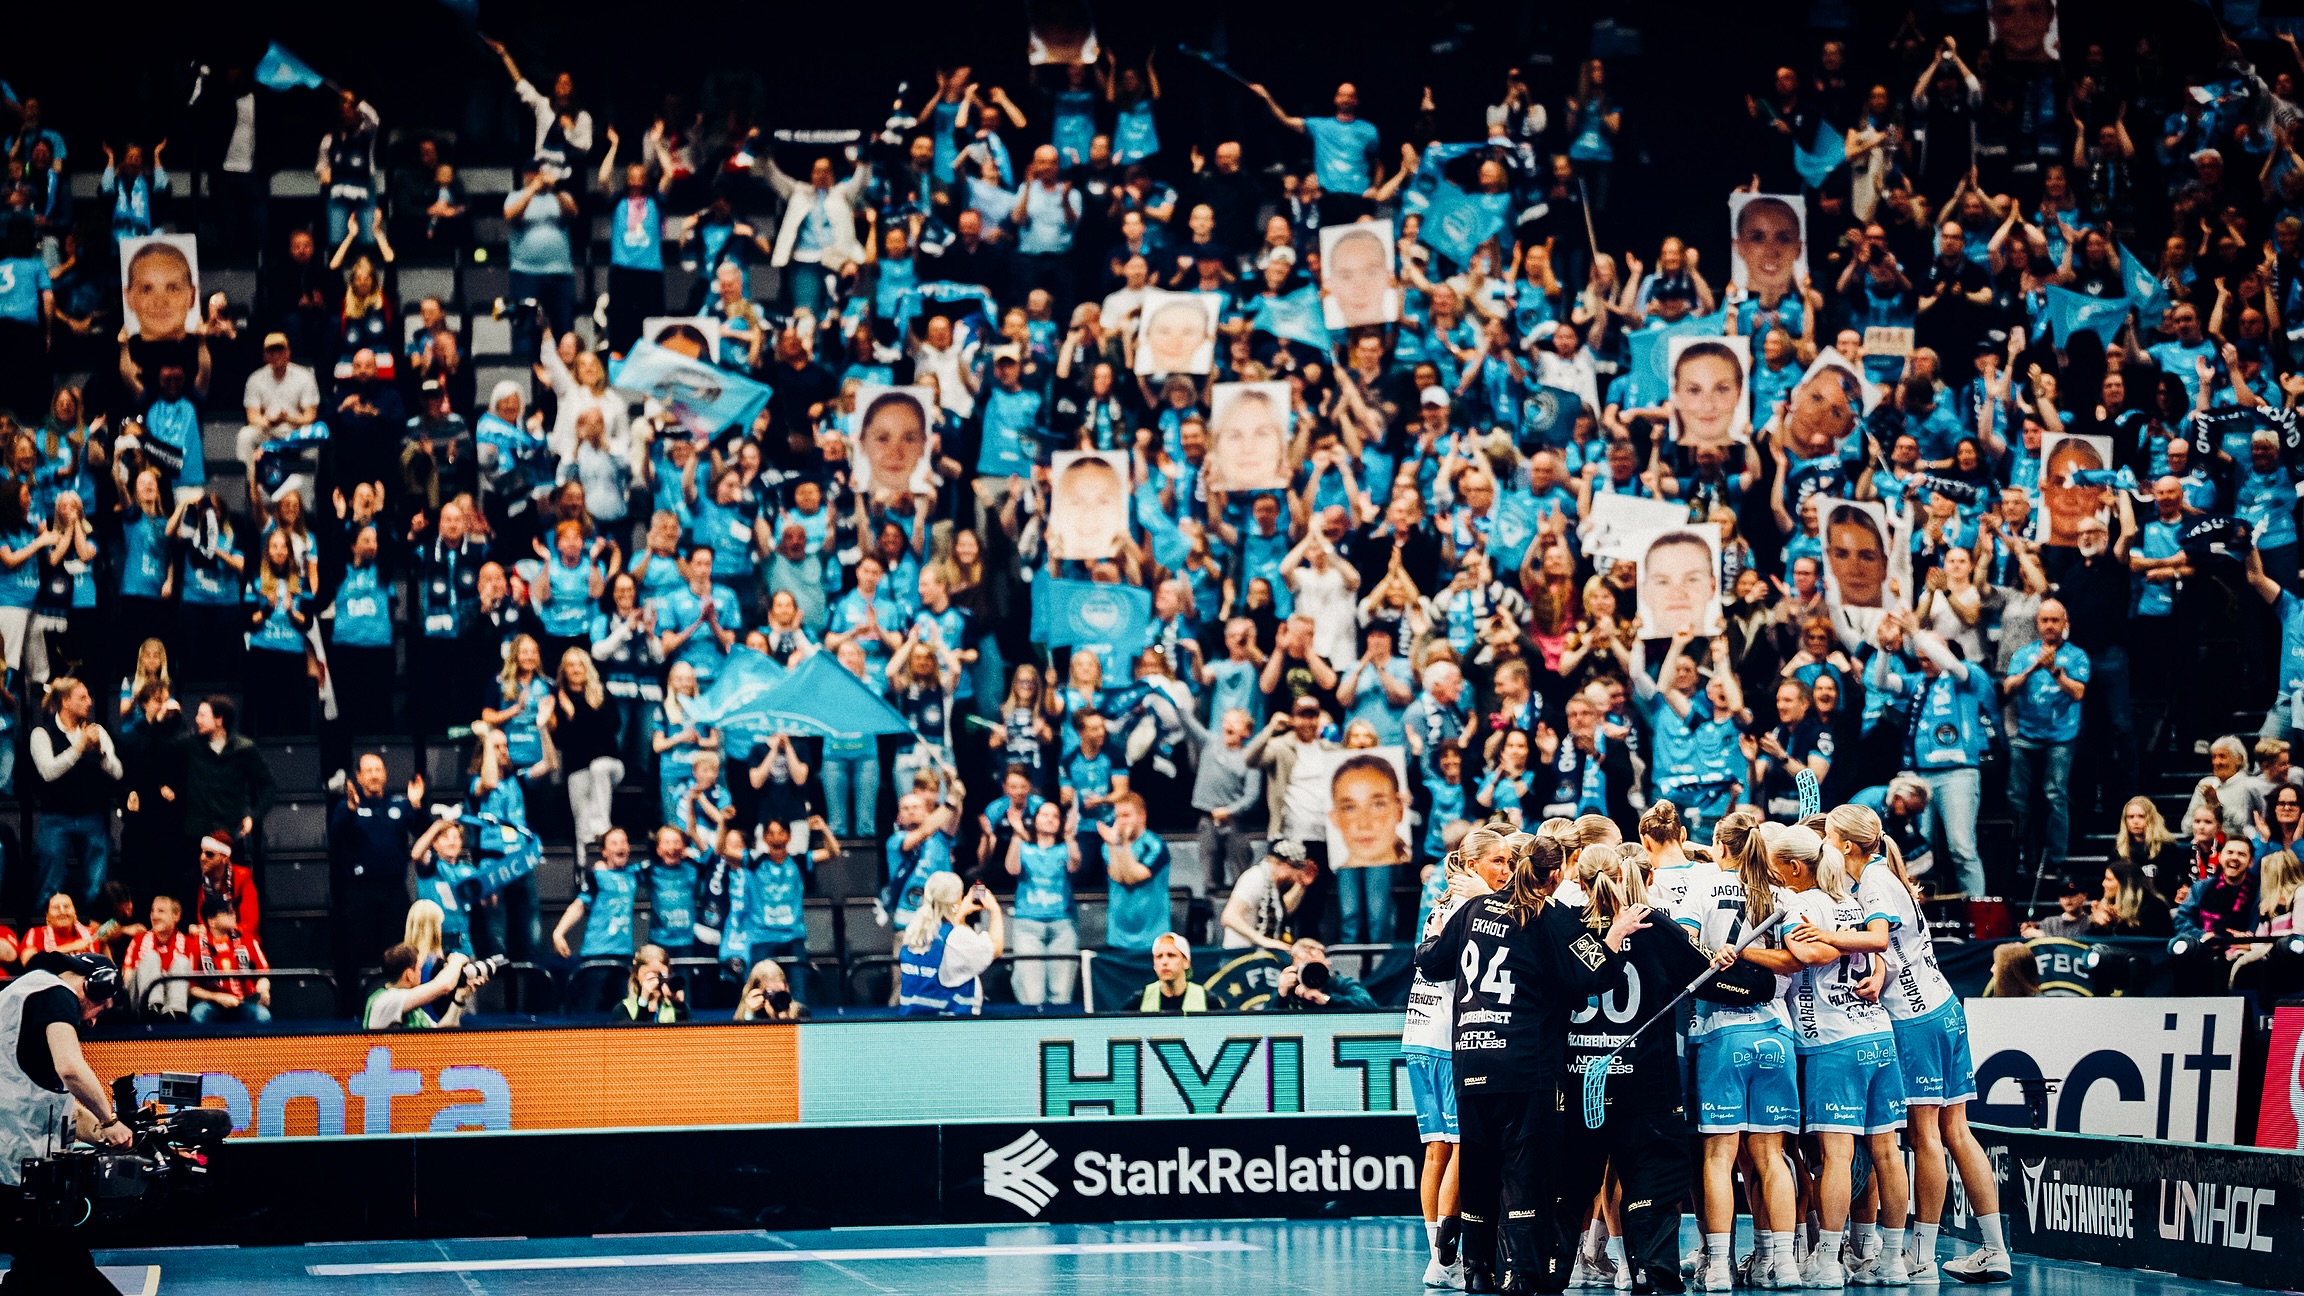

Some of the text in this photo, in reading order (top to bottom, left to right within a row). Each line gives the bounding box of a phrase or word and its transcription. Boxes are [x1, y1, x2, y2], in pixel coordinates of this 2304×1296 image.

[1471, 918, 1509, 938] EKHOLT
[1460, 939, 1516, 1005] 94
[1716, 982, 1750, 995] CORDURA
[1460, 1031, 1496, 1041] NORDIC
[1455, 1039, 1507, 1051] WELLNESS
[1733, 1051, 1786, 1064] Deurells
[1702, 1103, 1716, 1111] ICA
[1766, 1105, 1779, 1113] ICA
[1825, 1103, 1839, 1111] ICA
[1073, 1144, 1416, 1197] StarkRelation
[2158, 1178, 2277, 1253] UNIHOC
